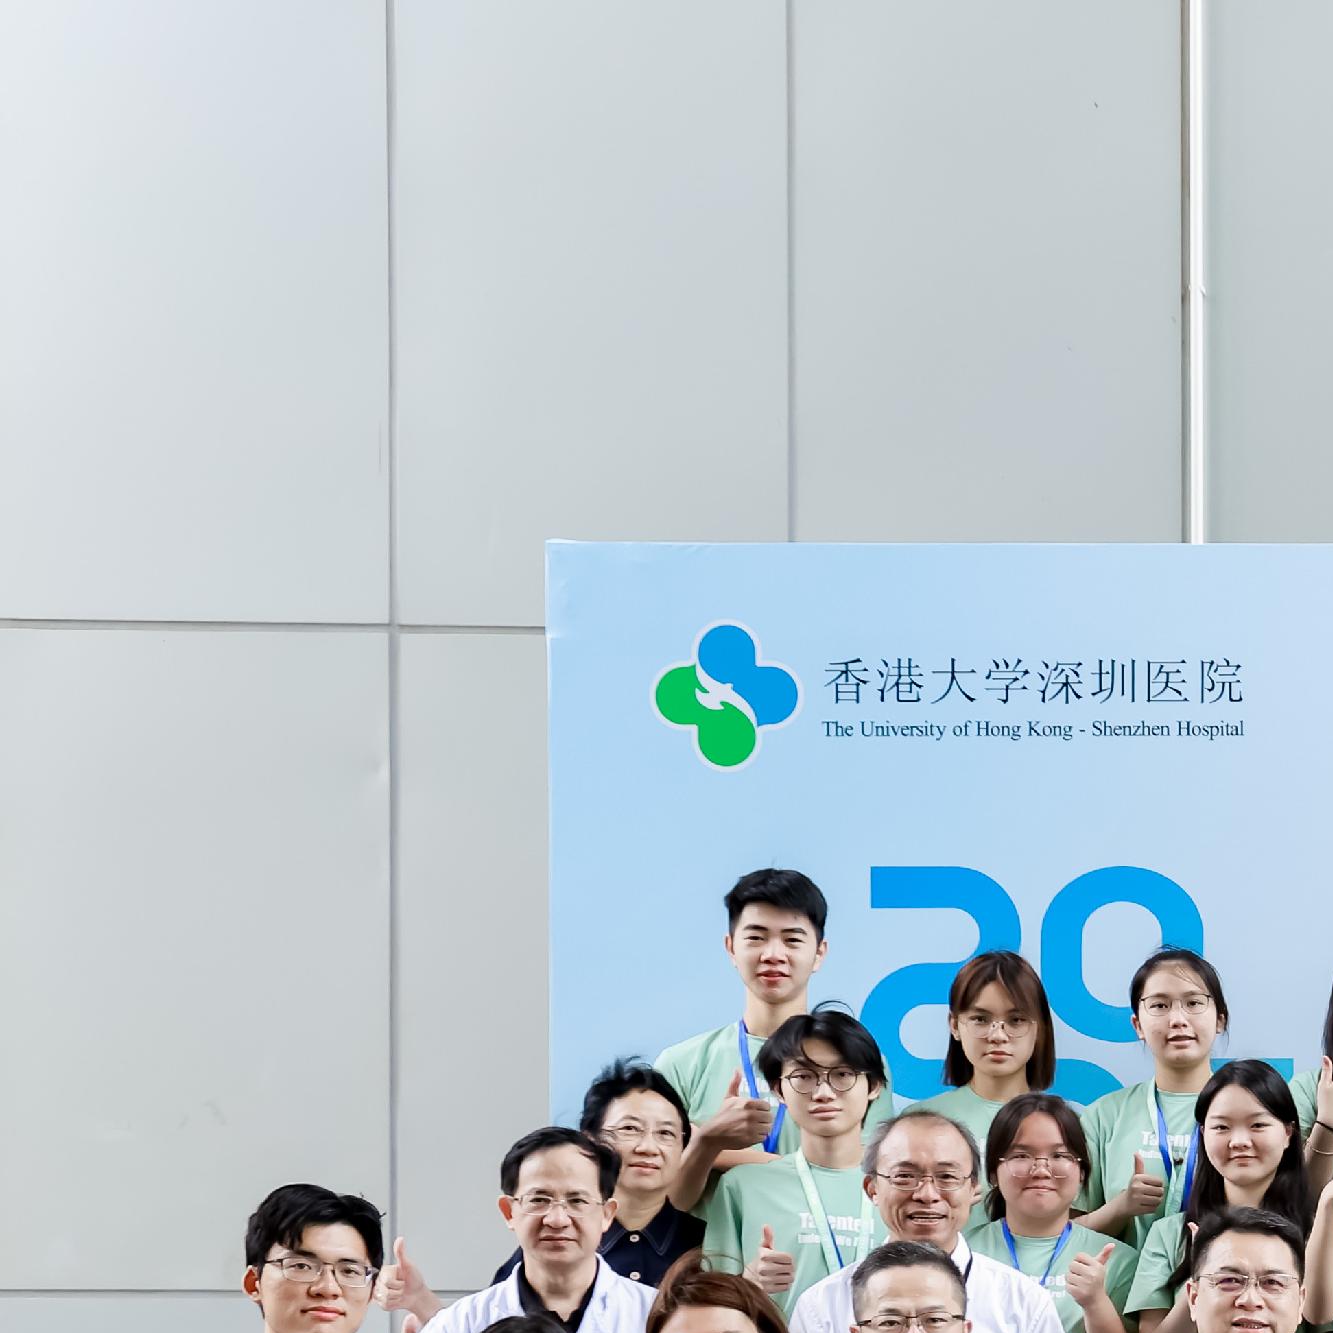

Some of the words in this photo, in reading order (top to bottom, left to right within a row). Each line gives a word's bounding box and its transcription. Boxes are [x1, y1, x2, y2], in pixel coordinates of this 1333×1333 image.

[825, 658, 1243, 704] 香港大学深圳医院
[822, 721, 853, 737] The
[861, 721, 946, 741] University
[953, 721, 971, 737] of
[976, 721, 1021, 741] Hong
[1028, 721, 1072, 741] Kong
[1093, 721, 1170, 737] Shenzhen
[1178, 721, 1243, 741] Hospital
